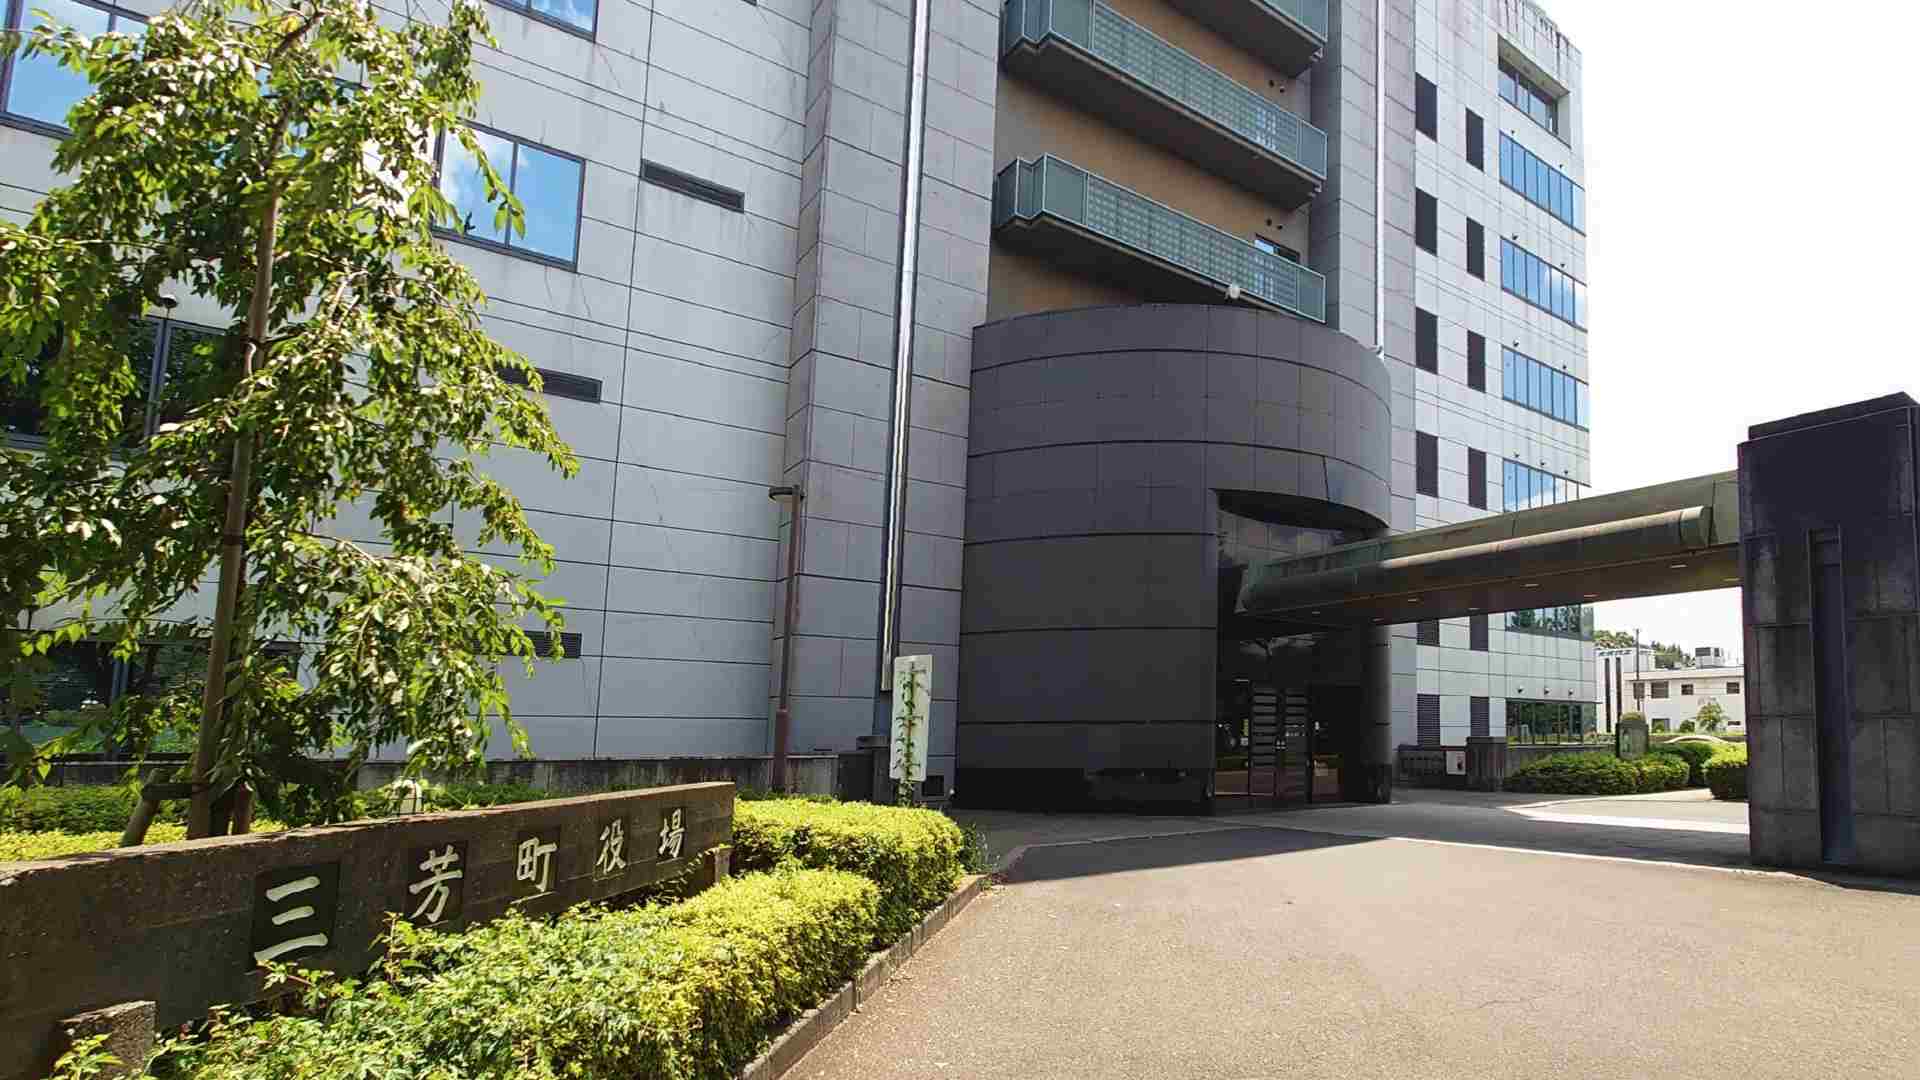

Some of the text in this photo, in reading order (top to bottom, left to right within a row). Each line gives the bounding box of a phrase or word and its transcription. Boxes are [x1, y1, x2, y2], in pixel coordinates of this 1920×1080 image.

[253, 808, 686, 961] 三芳町役場
